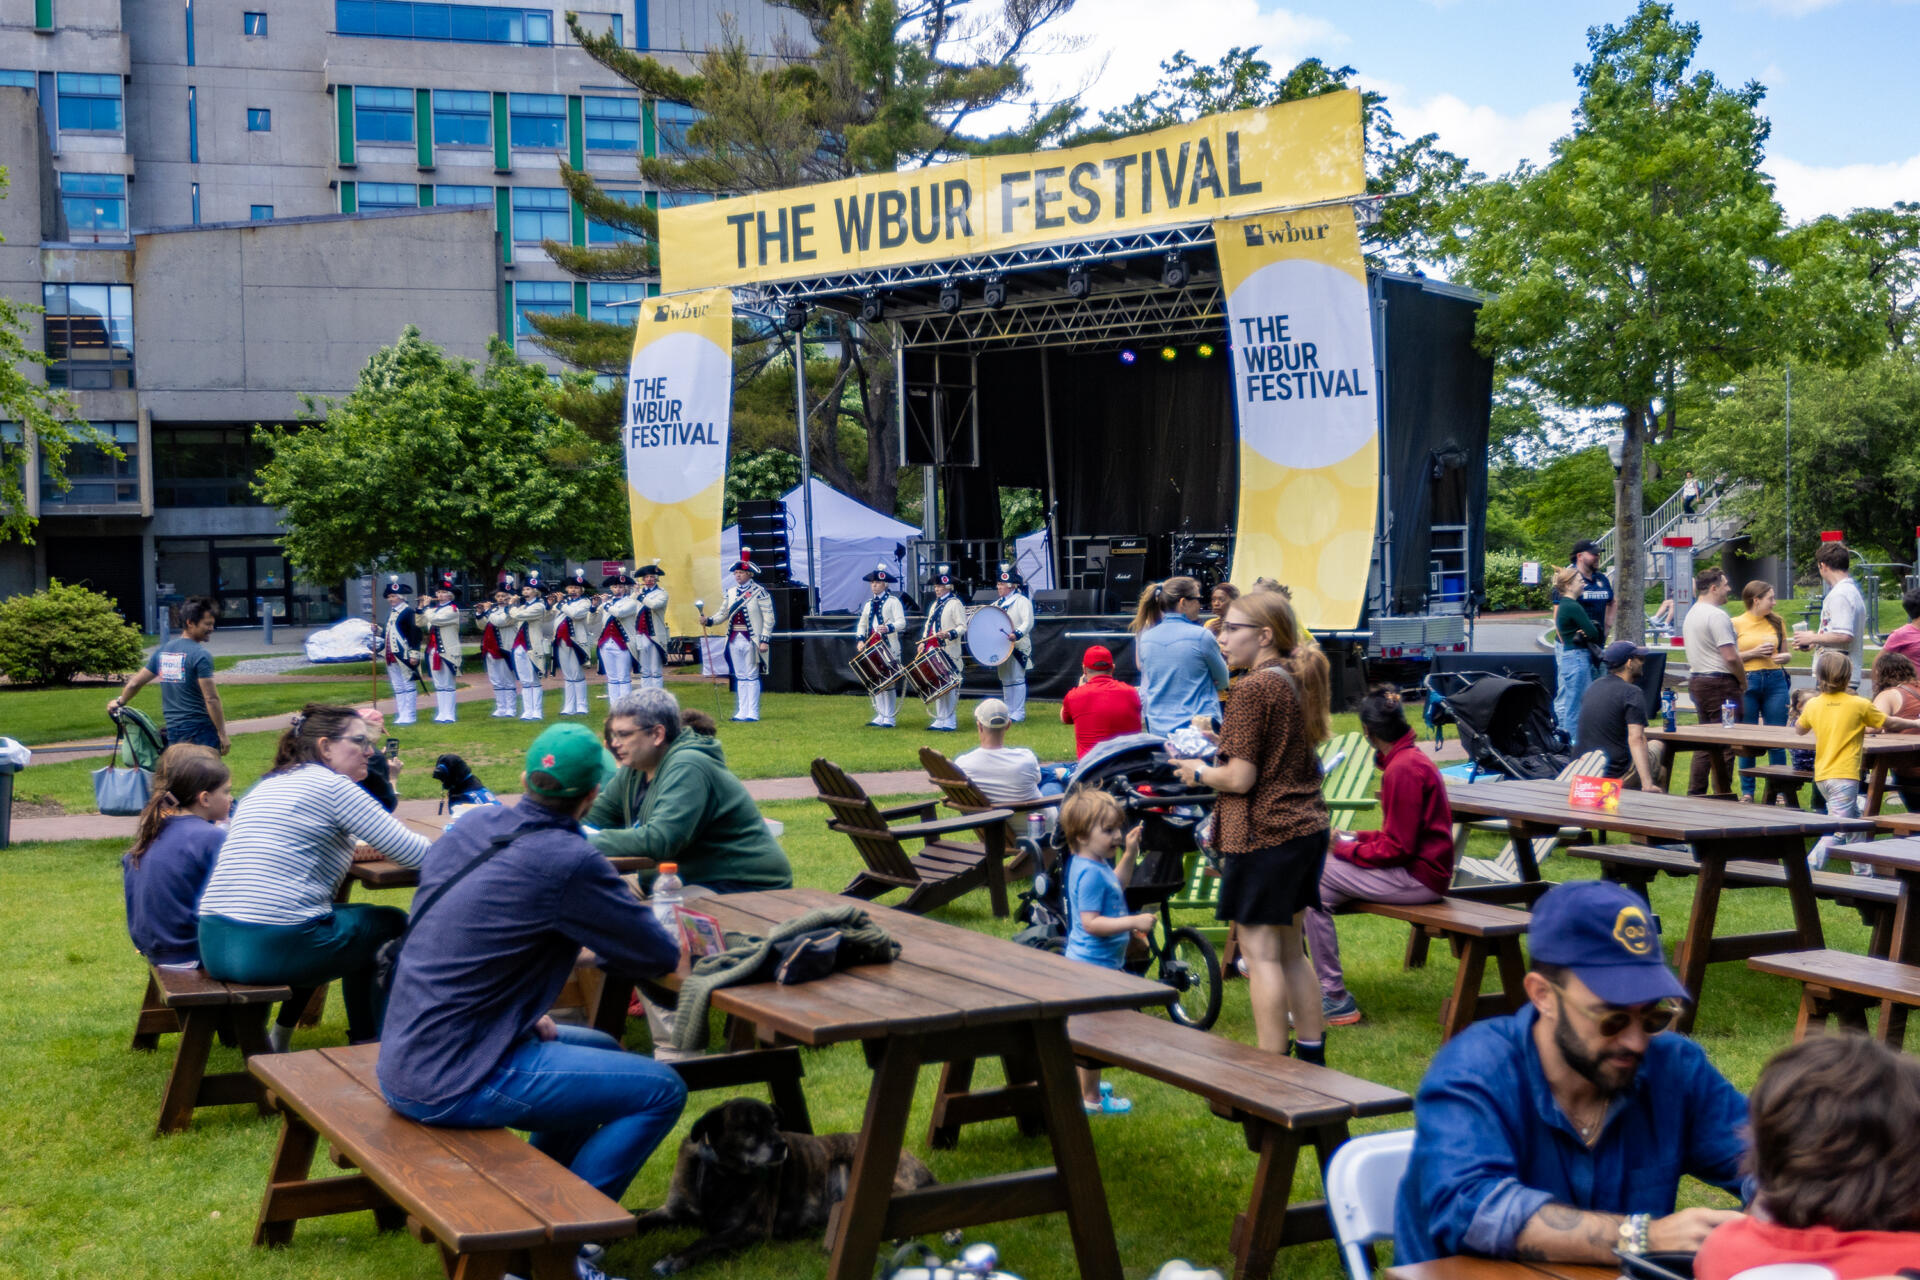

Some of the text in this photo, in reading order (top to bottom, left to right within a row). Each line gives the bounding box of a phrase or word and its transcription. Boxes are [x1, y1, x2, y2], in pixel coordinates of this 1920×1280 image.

[727, 130, 1262, 269] THE WBUR FESTIVAL
[1266, 221, 1329, 244] wbur
[670, 303, 709, 320] wbur
[1239, 315, 1291, 345] THE
[1243, 342, 1319, 373] WBUR
[634, 377, 667, 401] THE
[1247, 369, 1368, 402] FESTIVAL
[632, 400, 682, 424] WBUR
[631, 423, 719, 448] FESTIVAL
